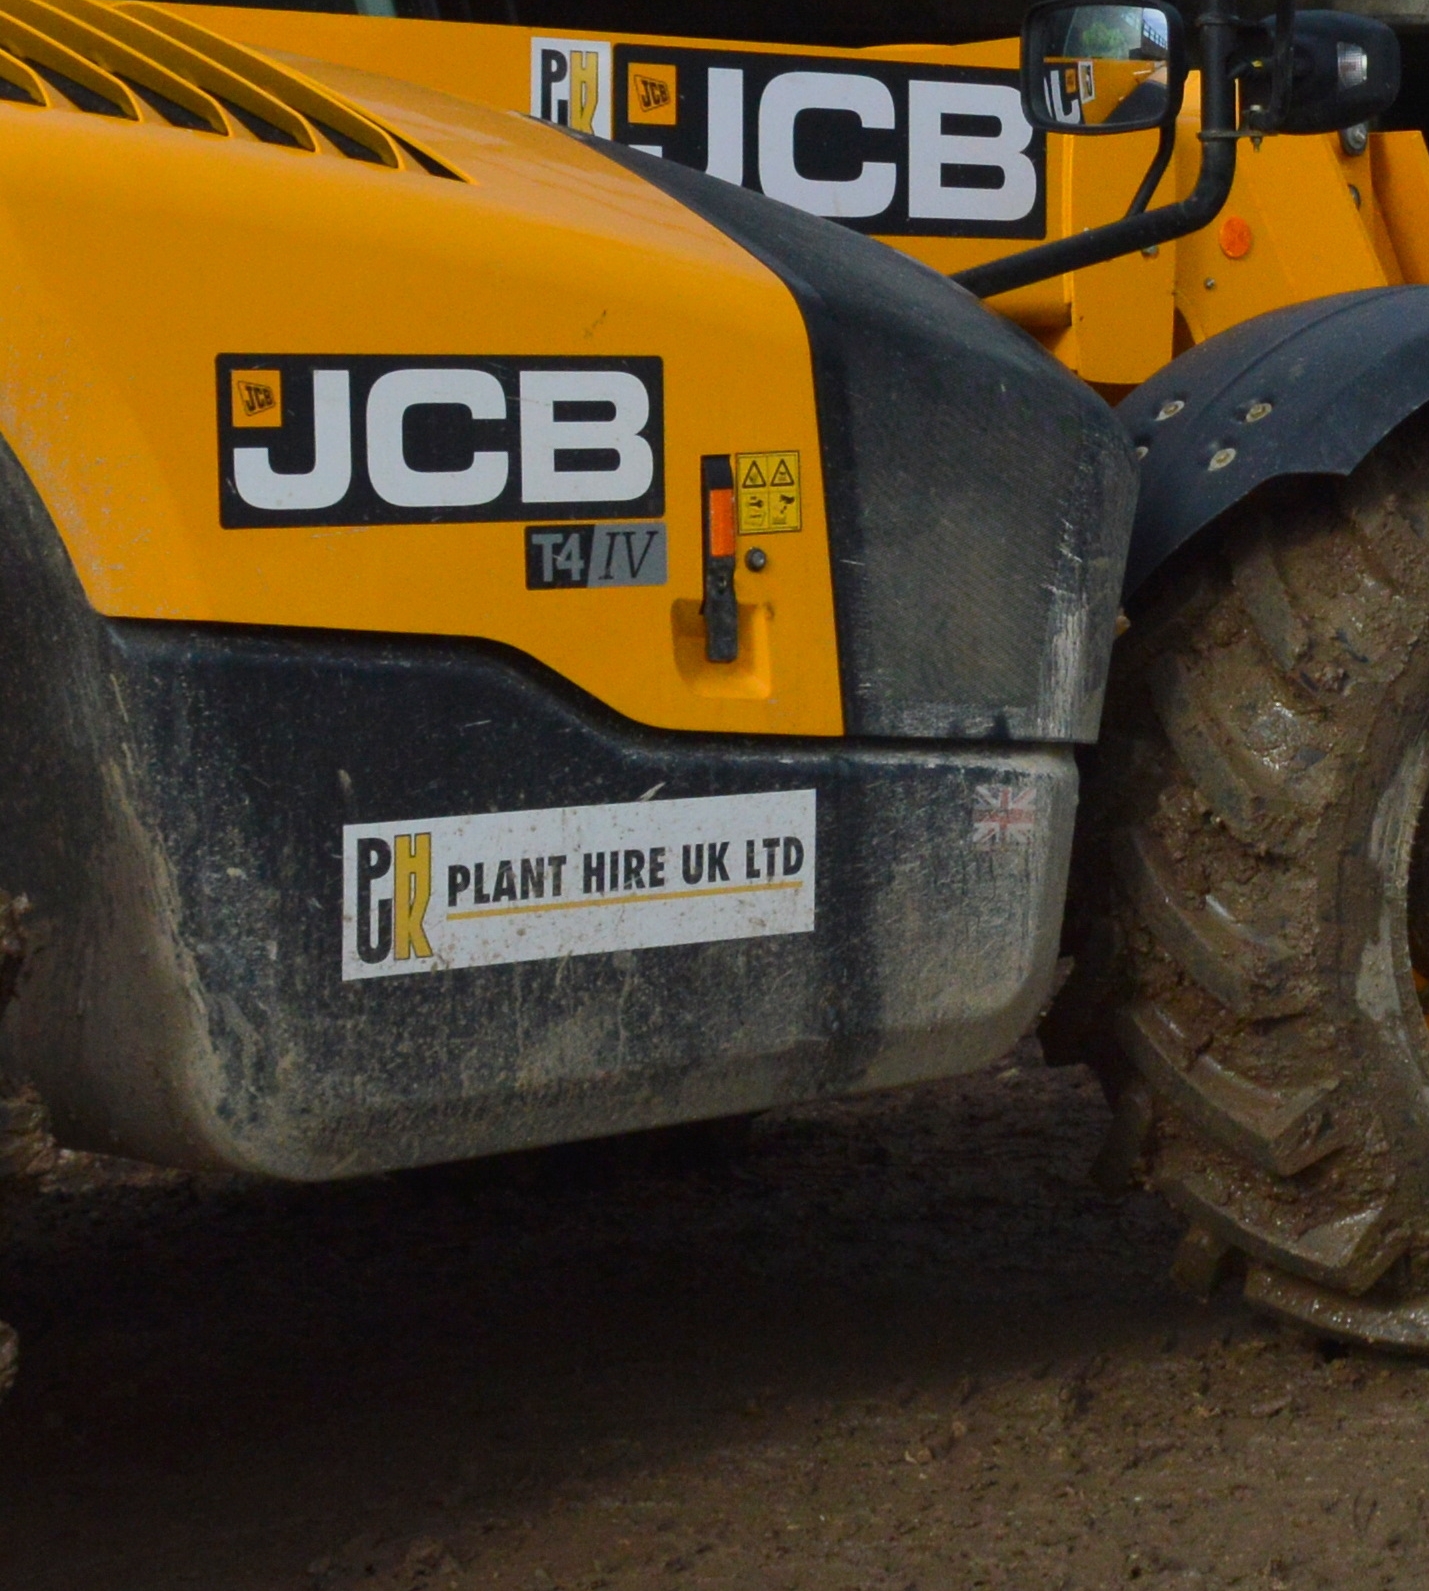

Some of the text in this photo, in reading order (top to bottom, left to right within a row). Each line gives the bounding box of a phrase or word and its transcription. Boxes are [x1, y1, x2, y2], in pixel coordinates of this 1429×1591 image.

[640, 80, 671, 107] JCB
[628, 67, 1037, 221] JCB
[245, 385, 274, 411] JCB
[233, 369, 654, 510] JCB
[447, 836, 804, 907] PLANT HIRE UK LTD
